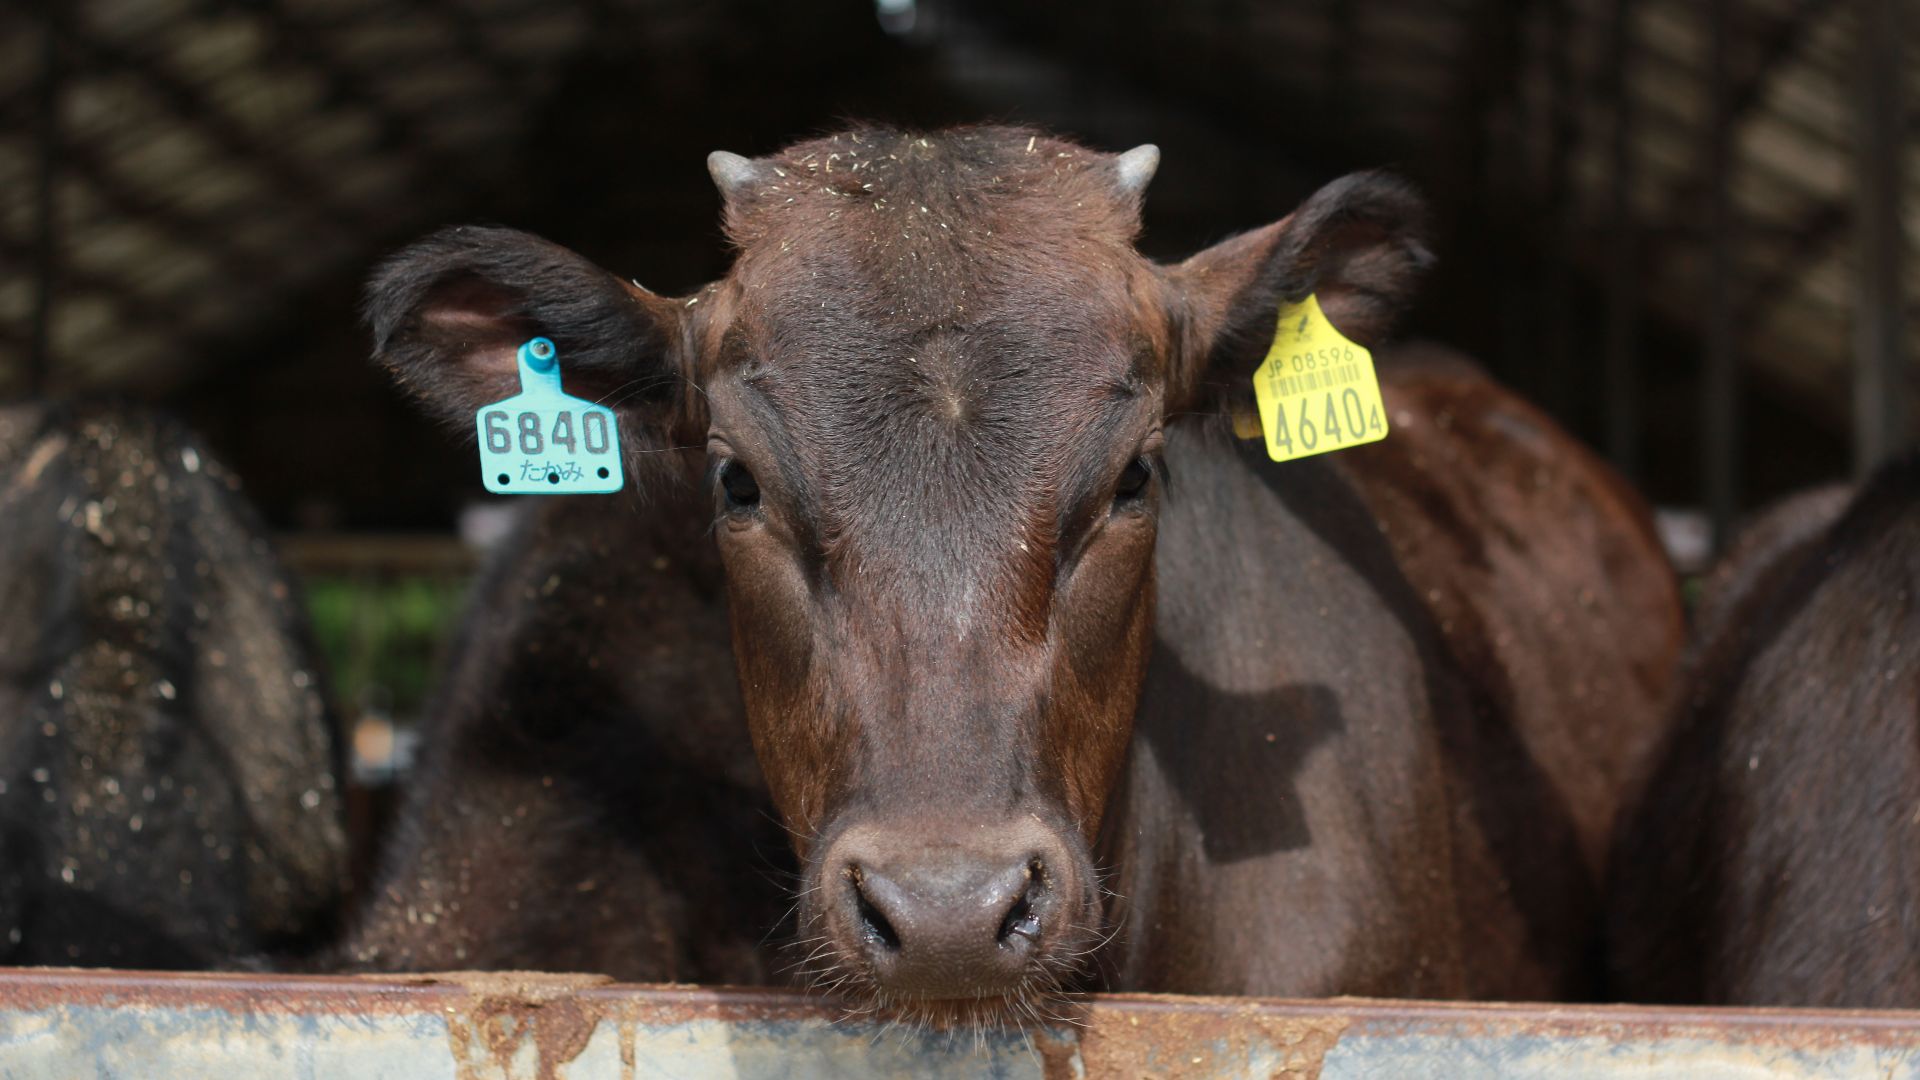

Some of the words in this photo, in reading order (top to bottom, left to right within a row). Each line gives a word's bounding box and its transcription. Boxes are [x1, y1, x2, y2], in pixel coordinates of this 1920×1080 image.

[1268, 359, 1283, 378] JP
[1292, 346, 1354, 372] 08596
[485, 411, 610, 455] 6840
